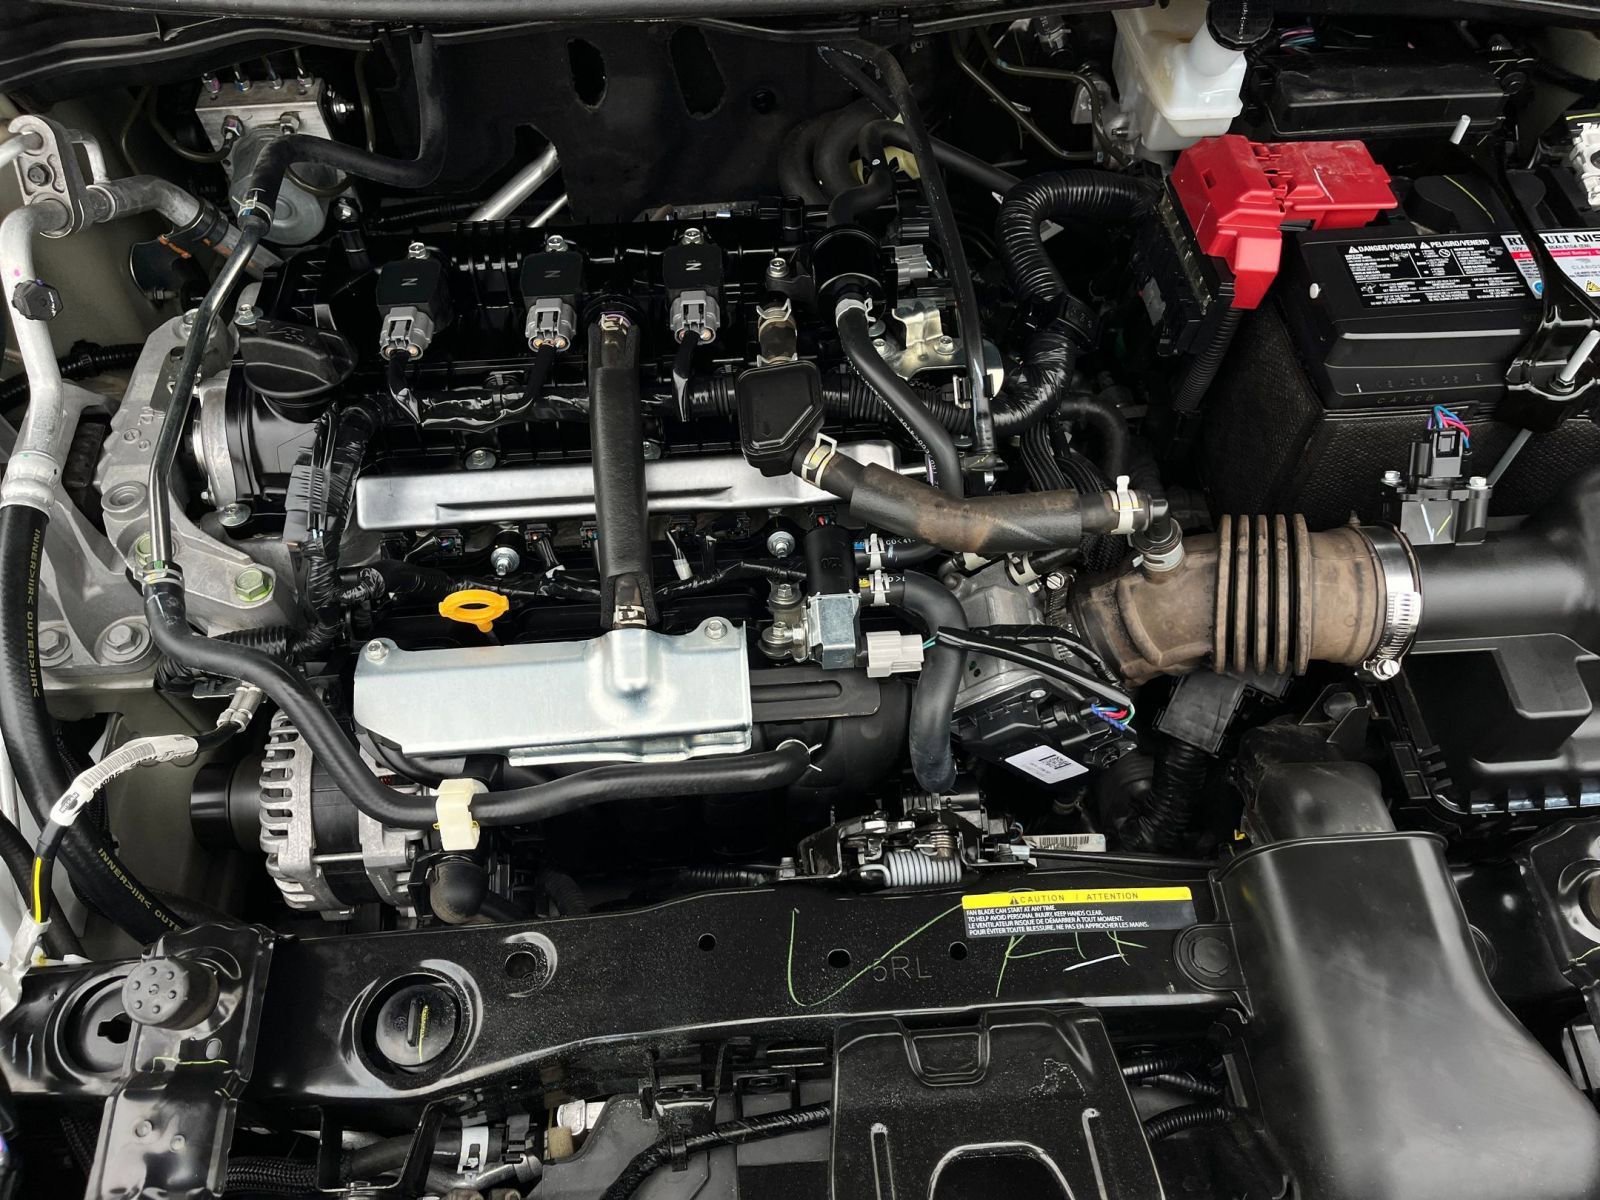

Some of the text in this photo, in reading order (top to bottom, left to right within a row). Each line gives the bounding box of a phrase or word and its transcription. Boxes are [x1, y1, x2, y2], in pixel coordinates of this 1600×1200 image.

[1357, 243, 1416, 252] DANGER/POISON
[1429, 239, 1490, 248] PELIGRO/VENENO
[1019, 894, 1065, 904] CAUTION
[1086, 892, 1139, 901] ATTENTION
[1007, 913, 1035, 921] PERSONAL
[975, 920, 1014, 929] VENTILATEUR
[1014, 919, 1036, 927] RISQUE
[1045, 916, 1077, 924] DÉMARRER
[987, 927, 1006, 935] ÉVITER
[1026, 925, 1056, 933] BLESSURE,
[1085, 921, 1120, 929] APPROCHER
